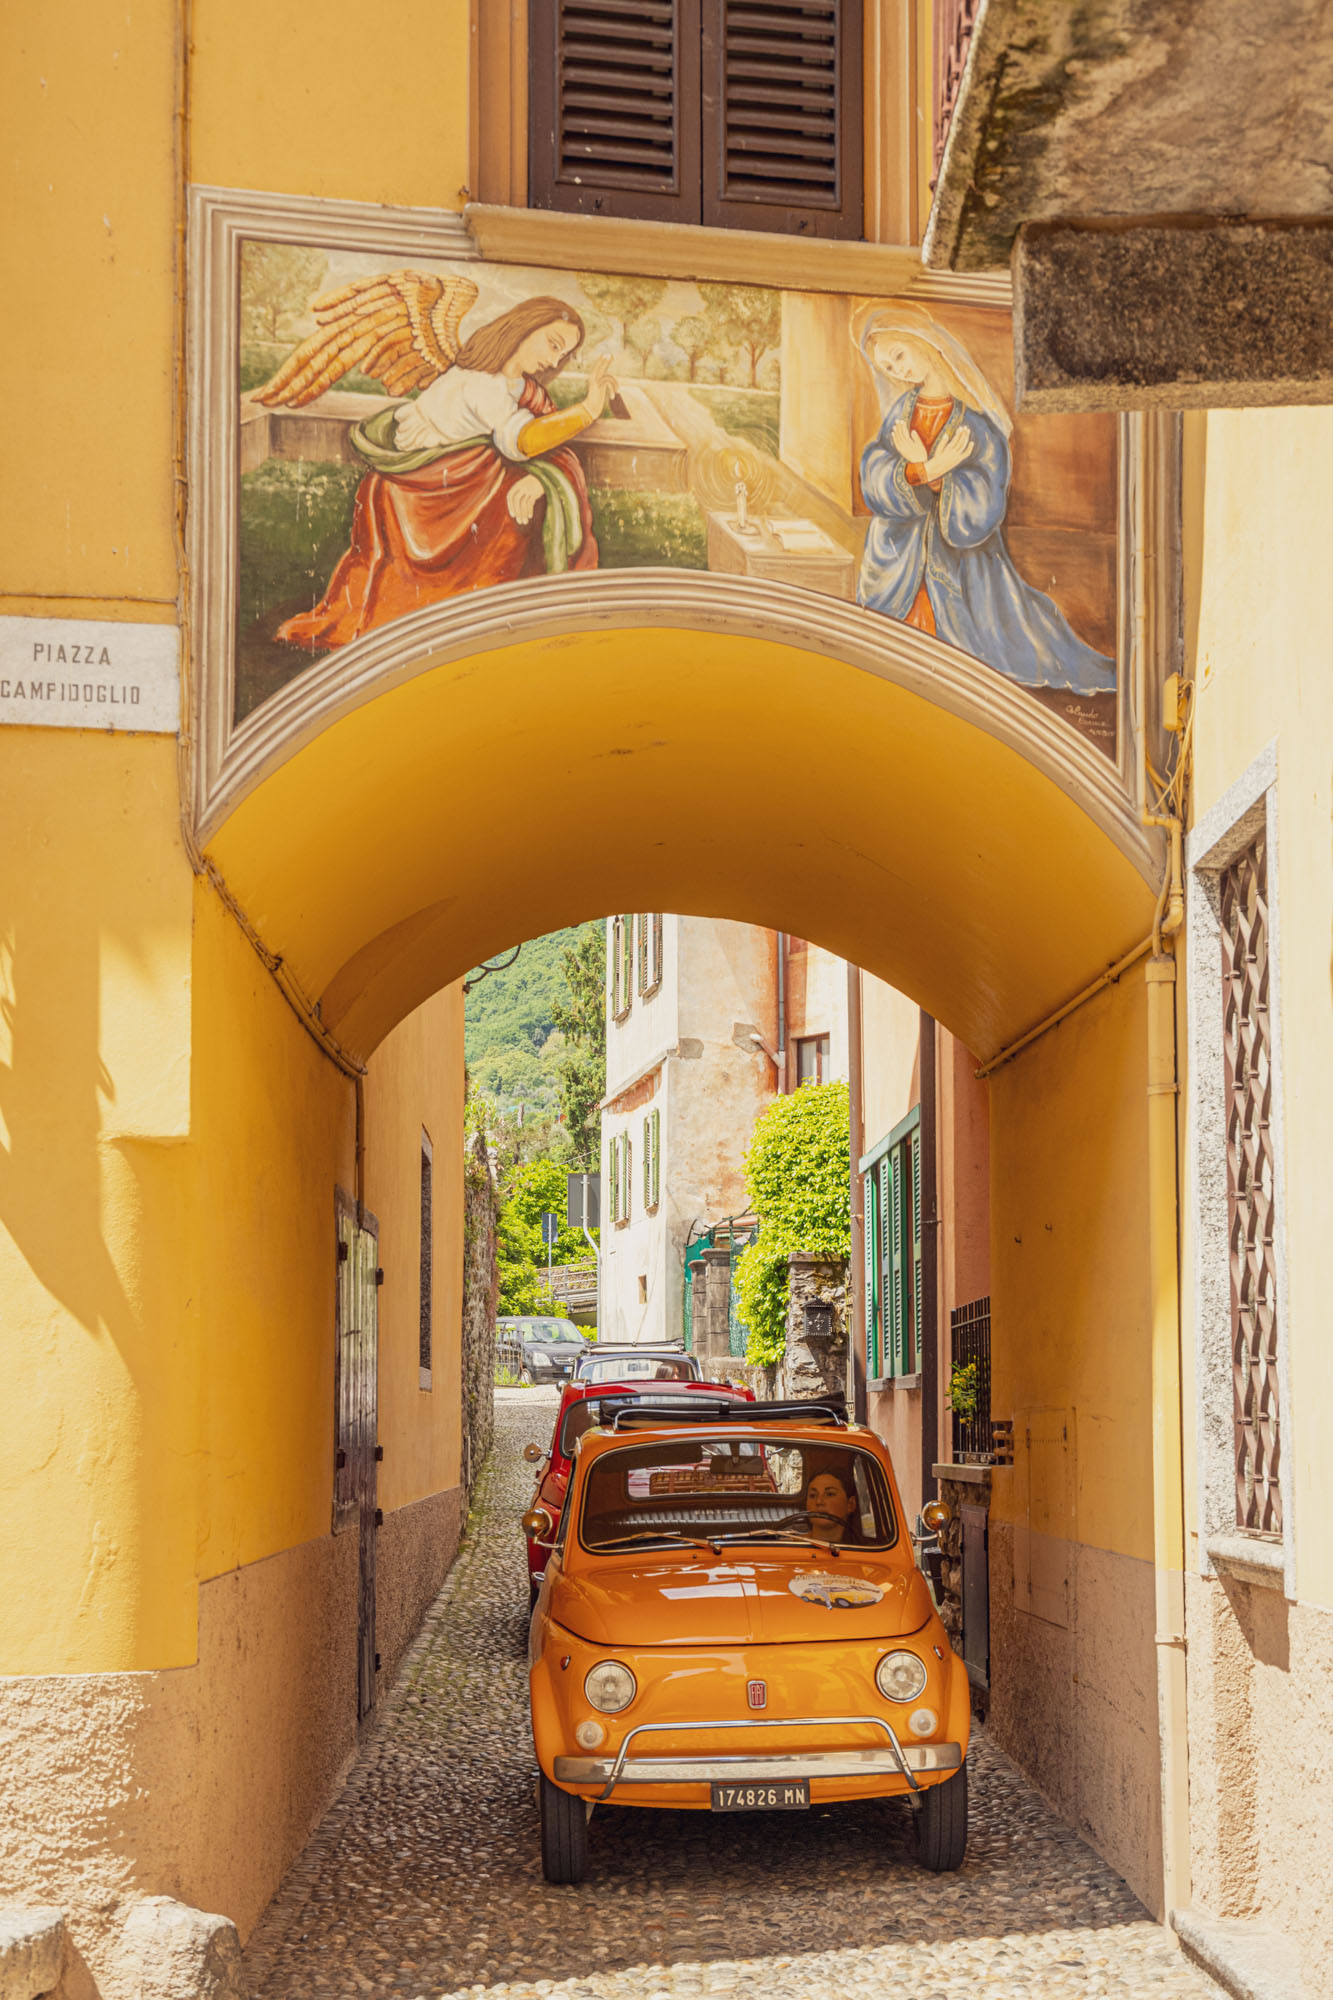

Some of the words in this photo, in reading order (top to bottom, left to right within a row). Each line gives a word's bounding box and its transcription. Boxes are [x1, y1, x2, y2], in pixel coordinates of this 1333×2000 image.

[33, 643, 112, 665] PIAZZA
[0, 680, 140, 704] CAMPIDOGLIO
[751, 1684, 765, 1705] FIAT
[718, 1789, 777, 1807] 174826
[784, 1788, 806, 1805] MN
